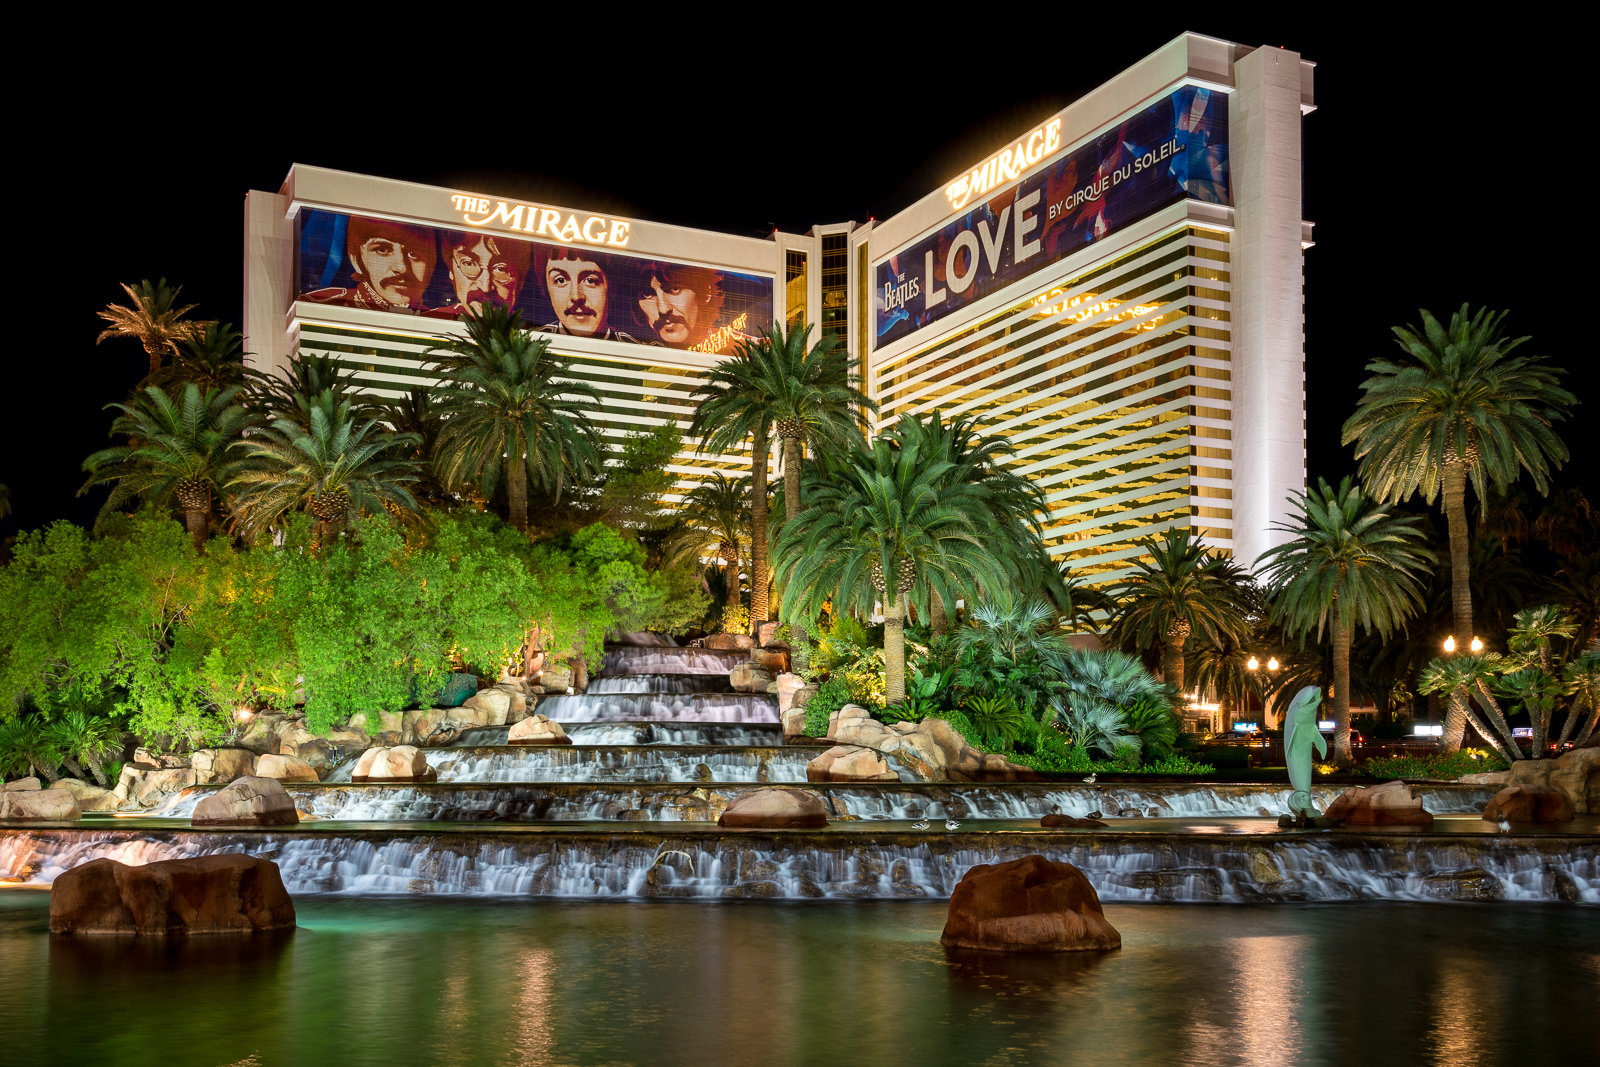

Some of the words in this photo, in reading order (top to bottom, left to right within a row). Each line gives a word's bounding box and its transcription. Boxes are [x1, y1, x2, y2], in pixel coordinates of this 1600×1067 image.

[953, 116, 1062, 210] MIRAGE
[450, 193, 491, 215] THE
[946, 174, 969, 202] THE
[1049, 200, 1064, 220] BY
[1065, 175, 1110, 210] CIRQUE
[1113, 166, 1131, 186] DU
[463, 201, 631, 247] MIRAGE
[925, 188, 1041, 311] LOVE
[884, 276, 920, 313] BEATLES
[897, 272, 906, 284] THE
